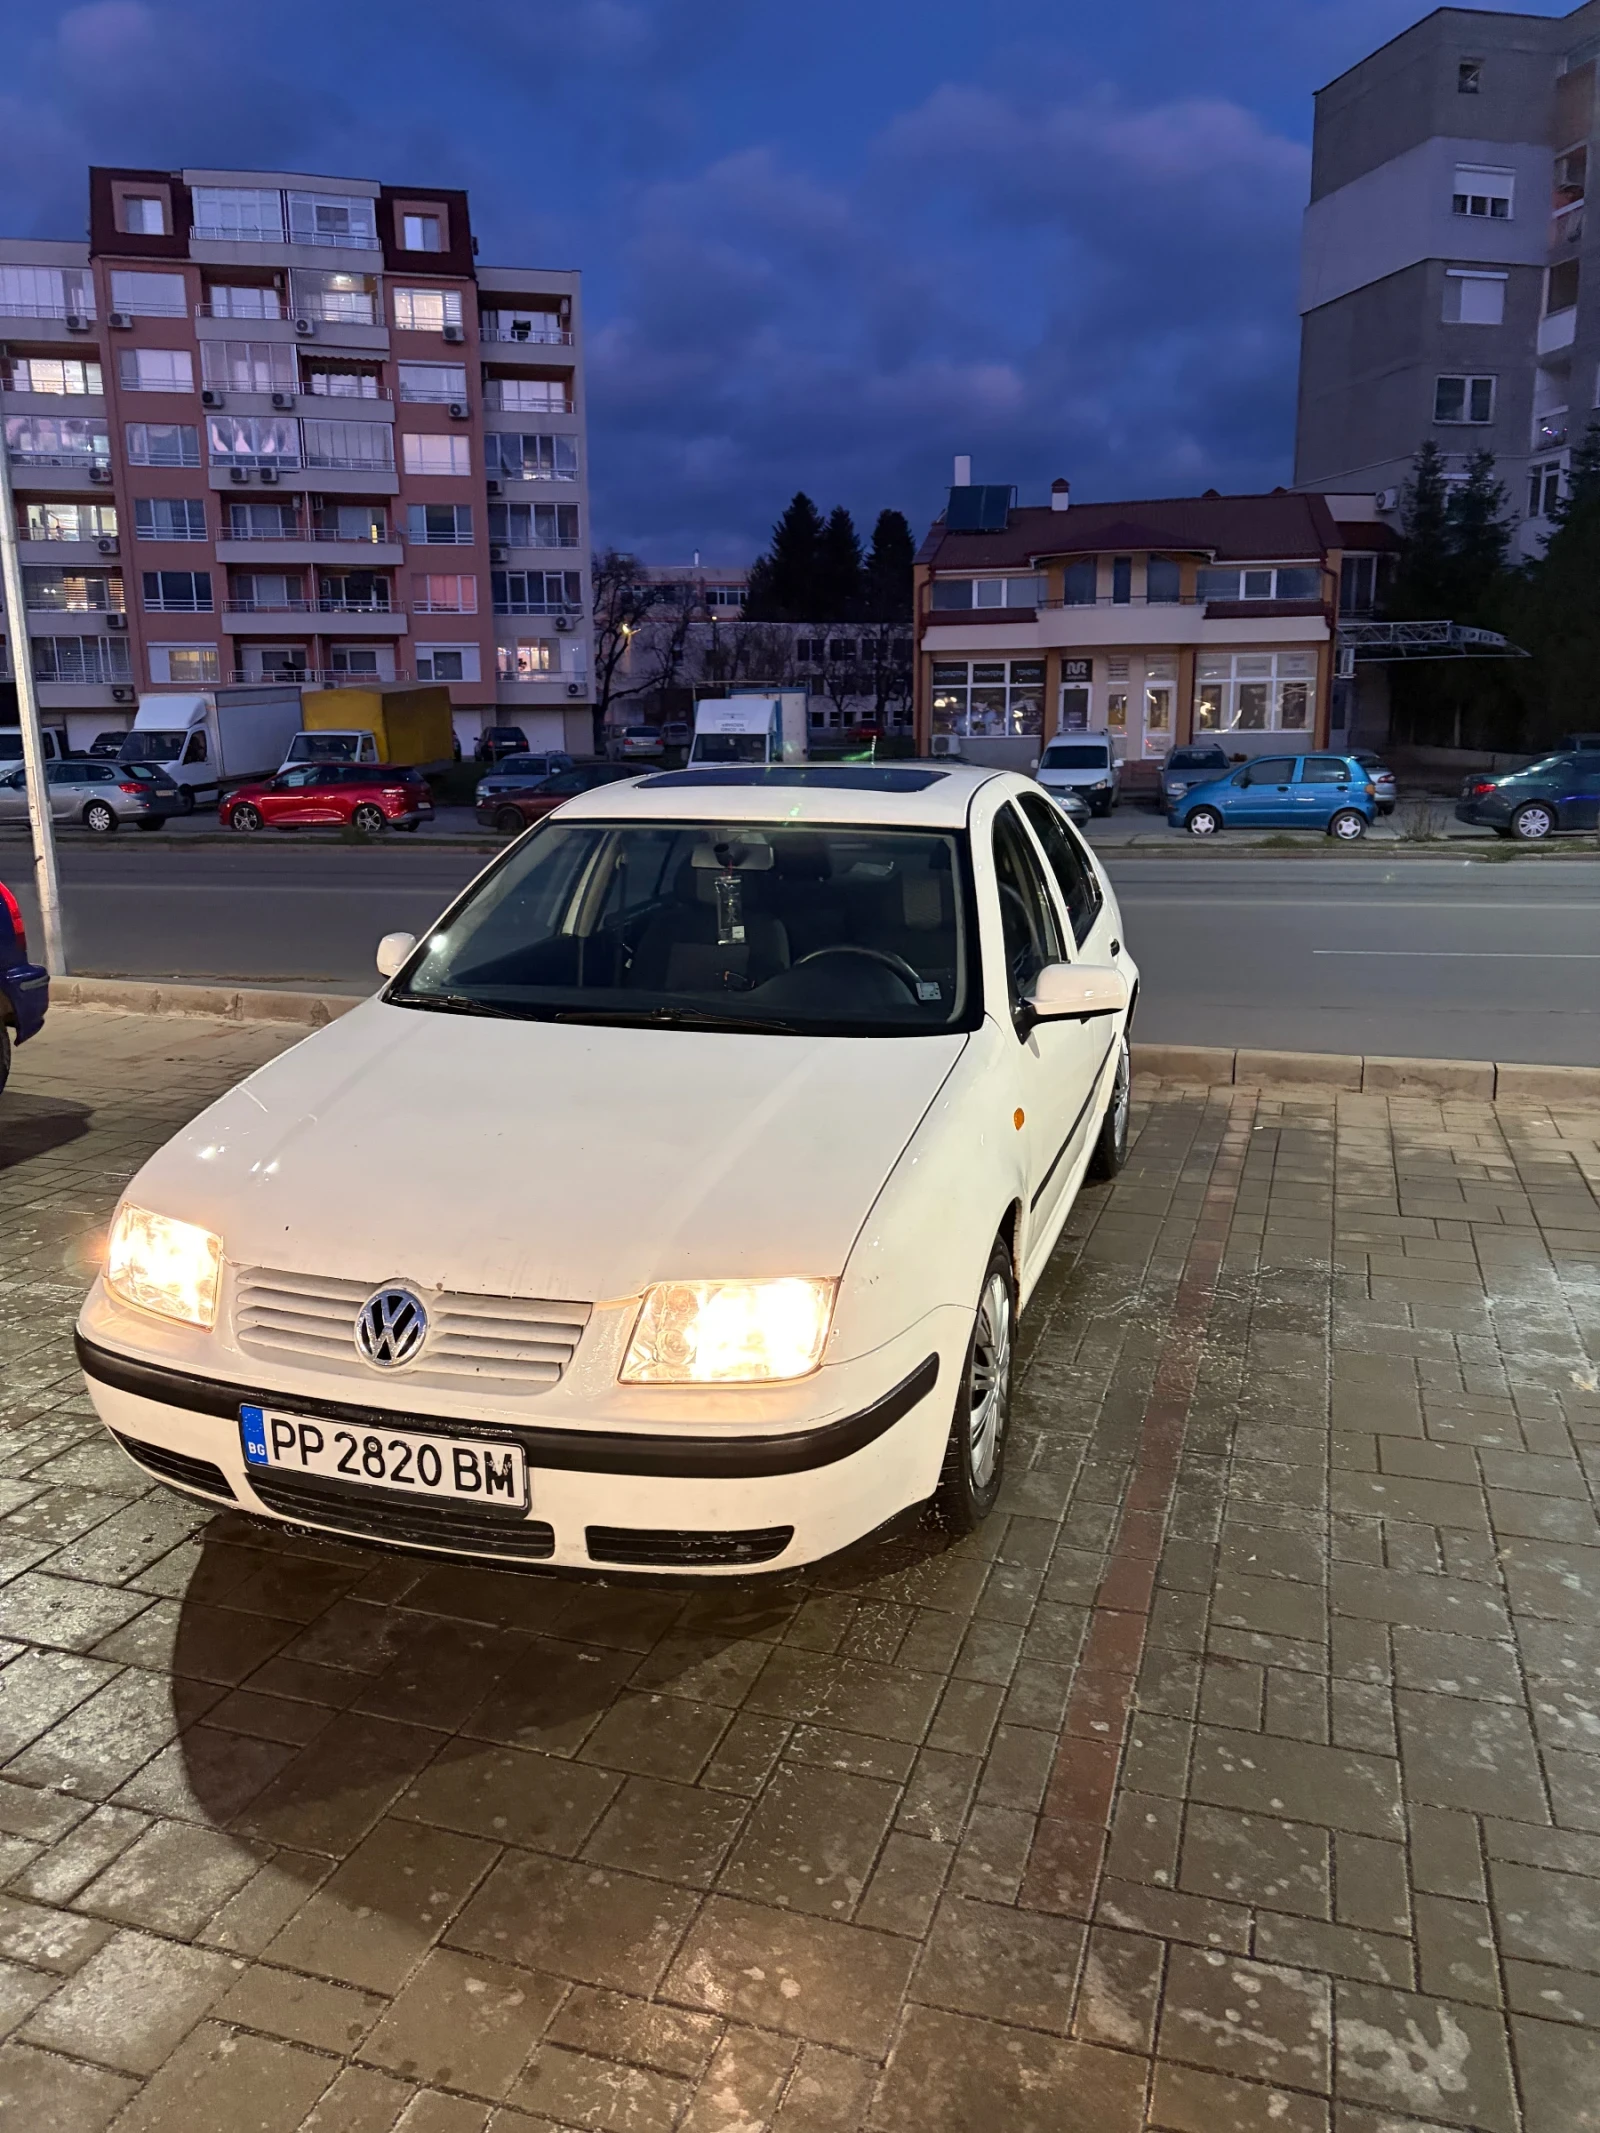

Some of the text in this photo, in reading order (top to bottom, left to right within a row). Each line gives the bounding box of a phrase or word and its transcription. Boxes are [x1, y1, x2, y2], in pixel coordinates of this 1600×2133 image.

[357, 1289, 425, 1365] VW
[247, 1441, 266, 1456] BG
[270, 1418, 515, 1498] PP 2820 BM
